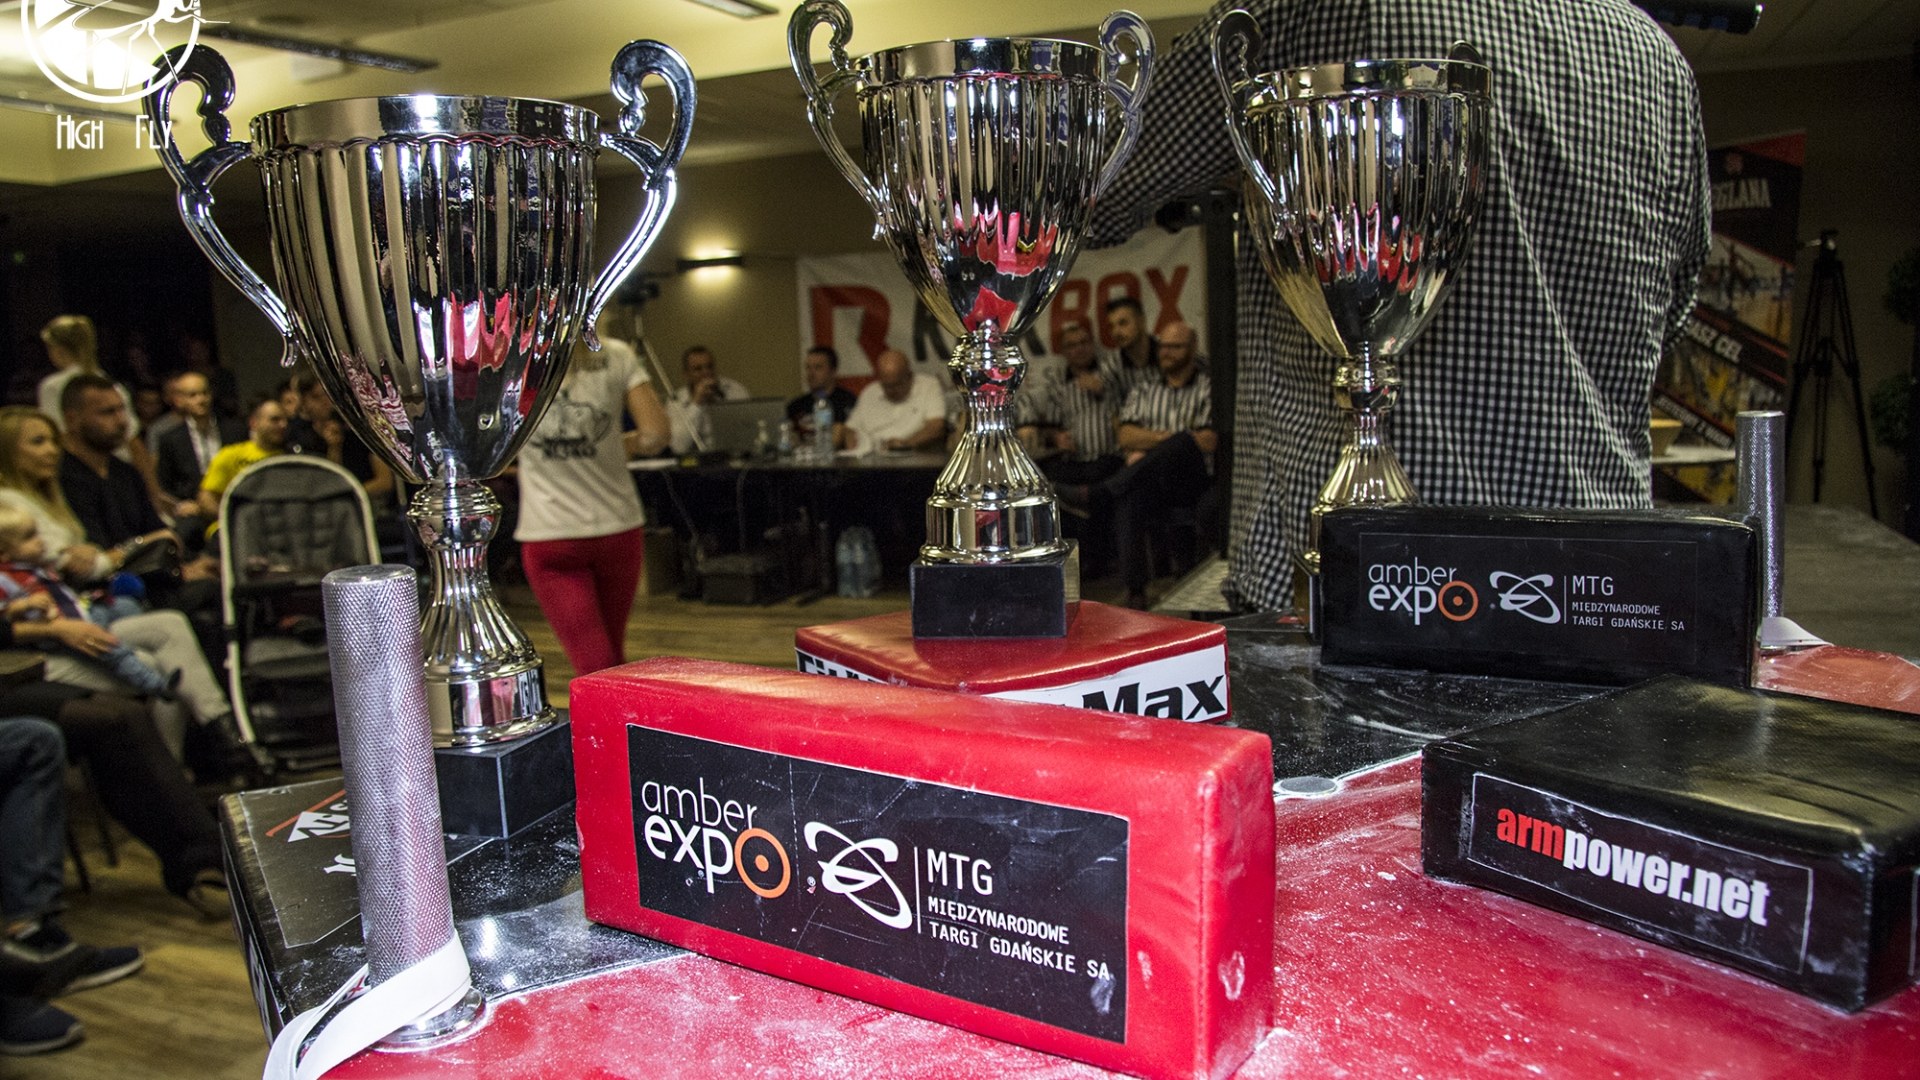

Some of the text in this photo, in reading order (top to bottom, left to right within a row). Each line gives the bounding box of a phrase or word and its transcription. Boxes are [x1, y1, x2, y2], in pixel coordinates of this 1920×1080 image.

[1368, 556, 1457, 586] amber
[1572, 575, 1614, 596] MTG
[1368, 580, 1479, 626] expo
[1571, 601, 1661, 616] MIĘDZYNARODOWE
[1572, 615, 1685, 631] TARGI GDAŃSKIE SA
[641, 776, 758, 832] amber
[643, 813, 791, 899] expo
[927, 848, 993, 896] MTG
[1496, 807, 1771, 926] armpower.net
[928, 896, 1070, 945] MIĘDZYNARODOWE
[929, 921, 1110, 981] TARGI GDAŃSKIE SA
